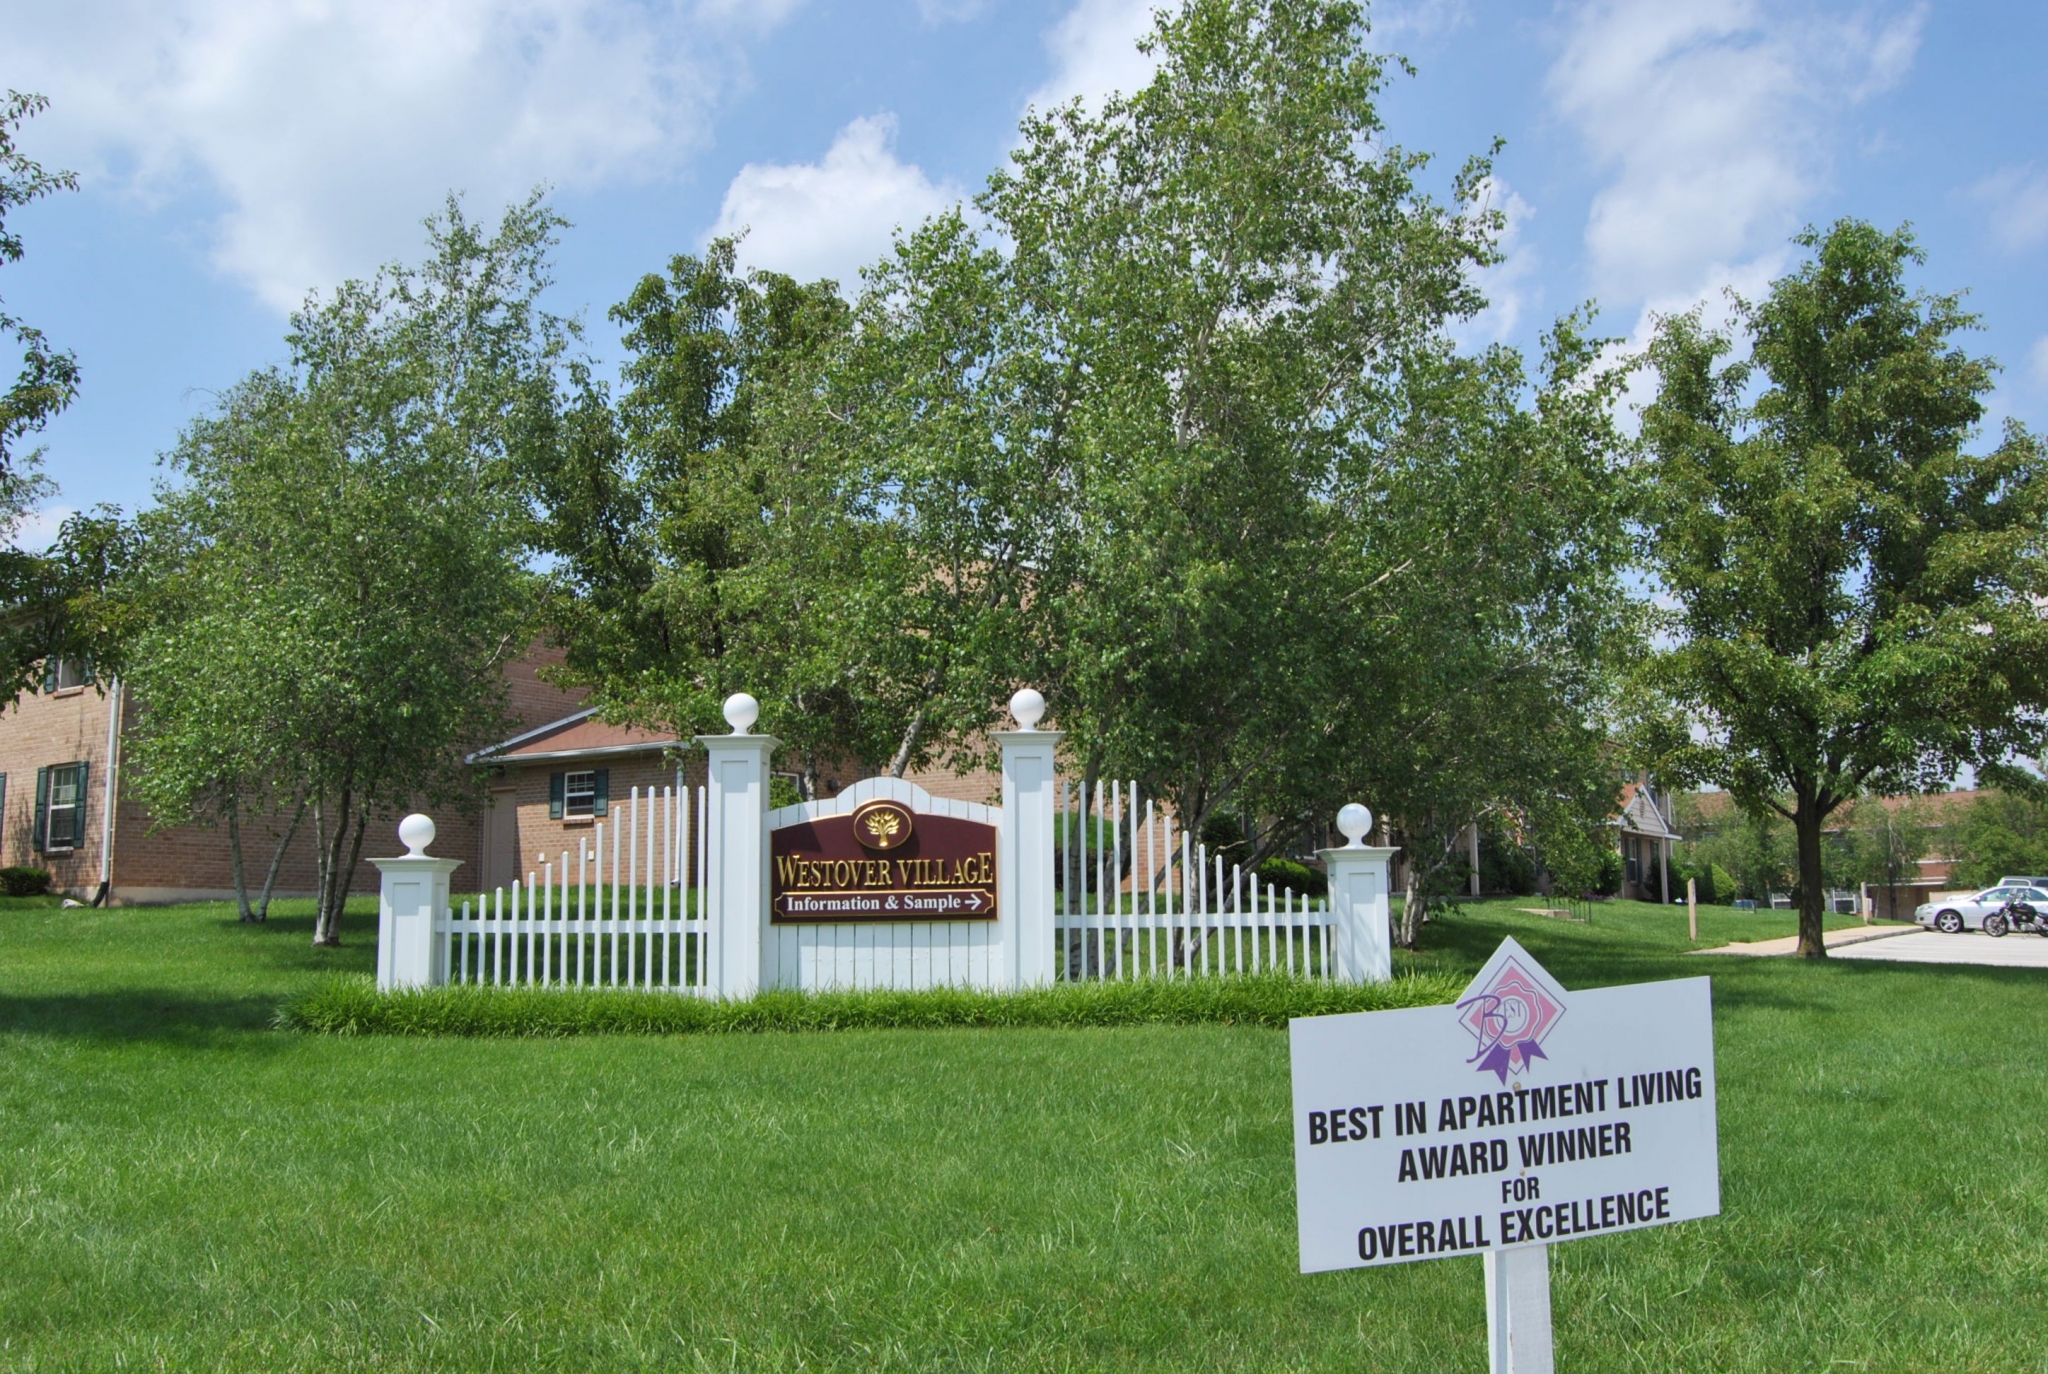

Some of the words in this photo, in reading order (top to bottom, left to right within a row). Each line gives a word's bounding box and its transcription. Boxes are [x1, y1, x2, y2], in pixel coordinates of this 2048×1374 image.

[776, 854, 892, 888] WESTOVER
[897, 852, 993, 885] VILLAGE
[787, 896, 880, 912] Information
[884, 894, 899, 910] &
[904, 893, 961, 912] Sample
[1308, 1104, 1384, 1145] BEST
[1395, 1101, 1427, 1136] IN
[1438, 1078, 1608, 1132] APARTMENT
[1617, 1067, 1702, 1109] LIVING
[1397, 1138, 1508, 1183] AWARD
[1517, 1121, 1632, 1168] WINNER
[1501, 1176, 1540, 1204] FOR
[1357, 1214, 1491, 1261] OVERALL
[1500, 1186, 1670, 1245] EXCELLENCE
